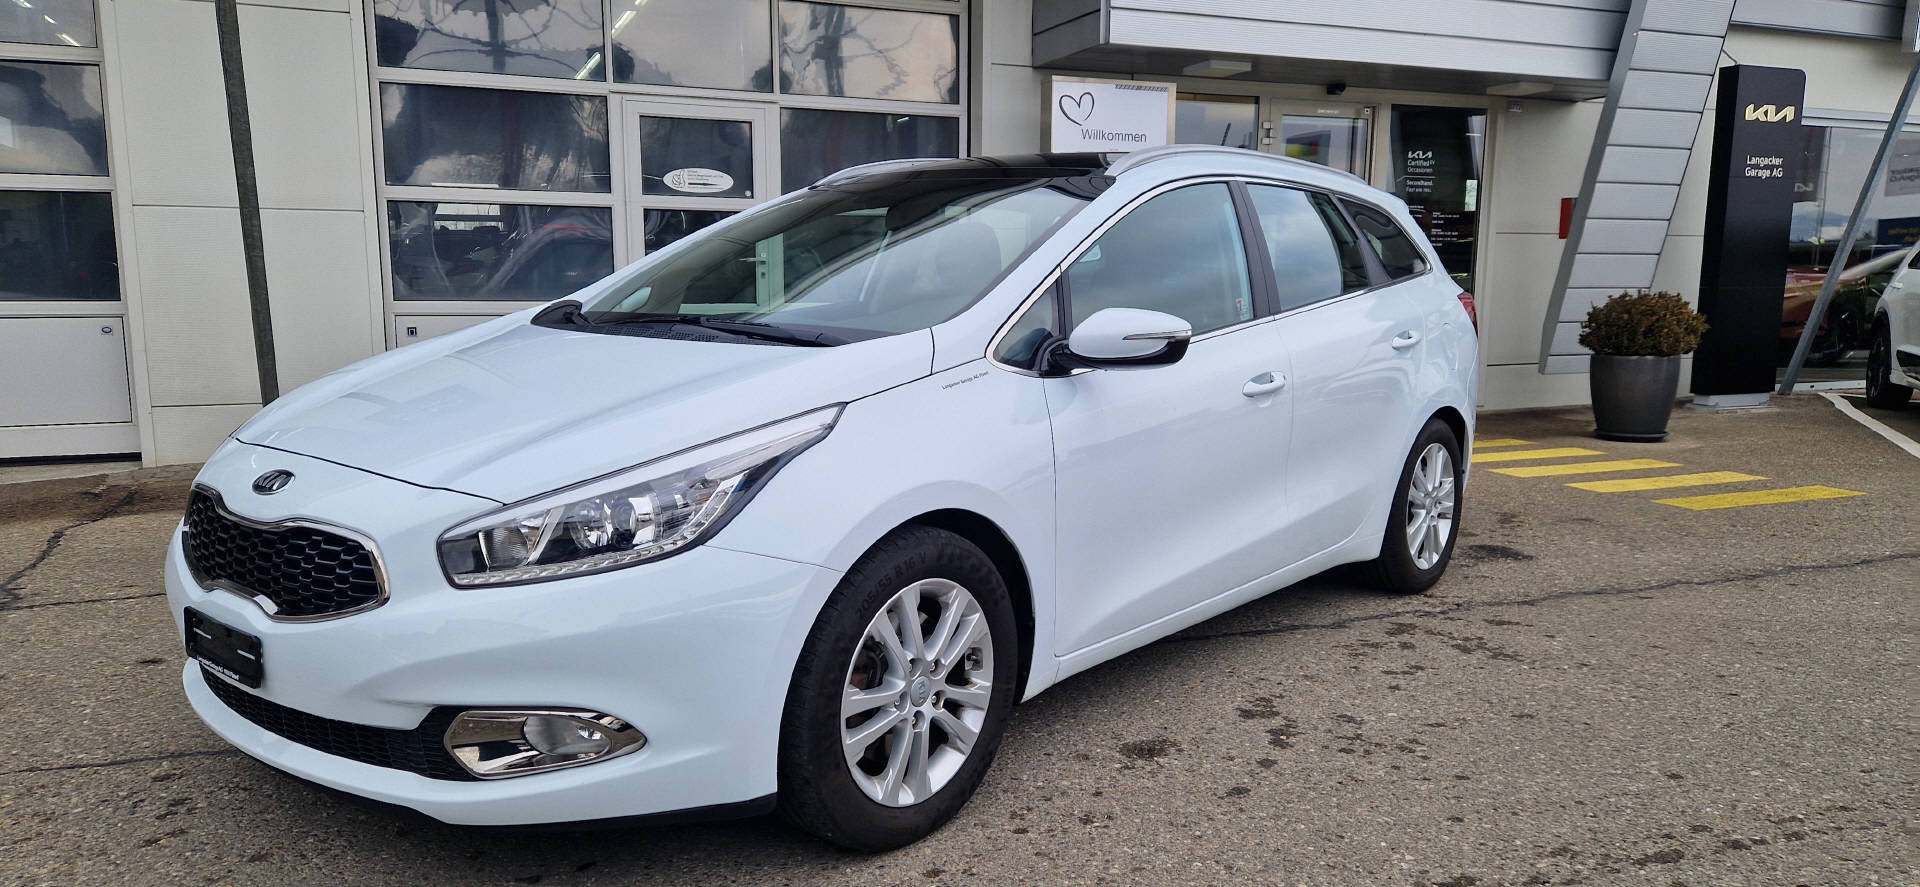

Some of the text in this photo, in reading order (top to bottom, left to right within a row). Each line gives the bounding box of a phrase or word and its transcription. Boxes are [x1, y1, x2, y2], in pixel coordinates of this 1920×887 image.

[1745, 103, 1796, 123] KIA
[1081, 128, 1147, 143] Willkommen
[1408, 151, 1432, 159] KIA
[1747, 154, 1784, 167] Langacker
[1745, 167, 1783, 179] Garage AG
